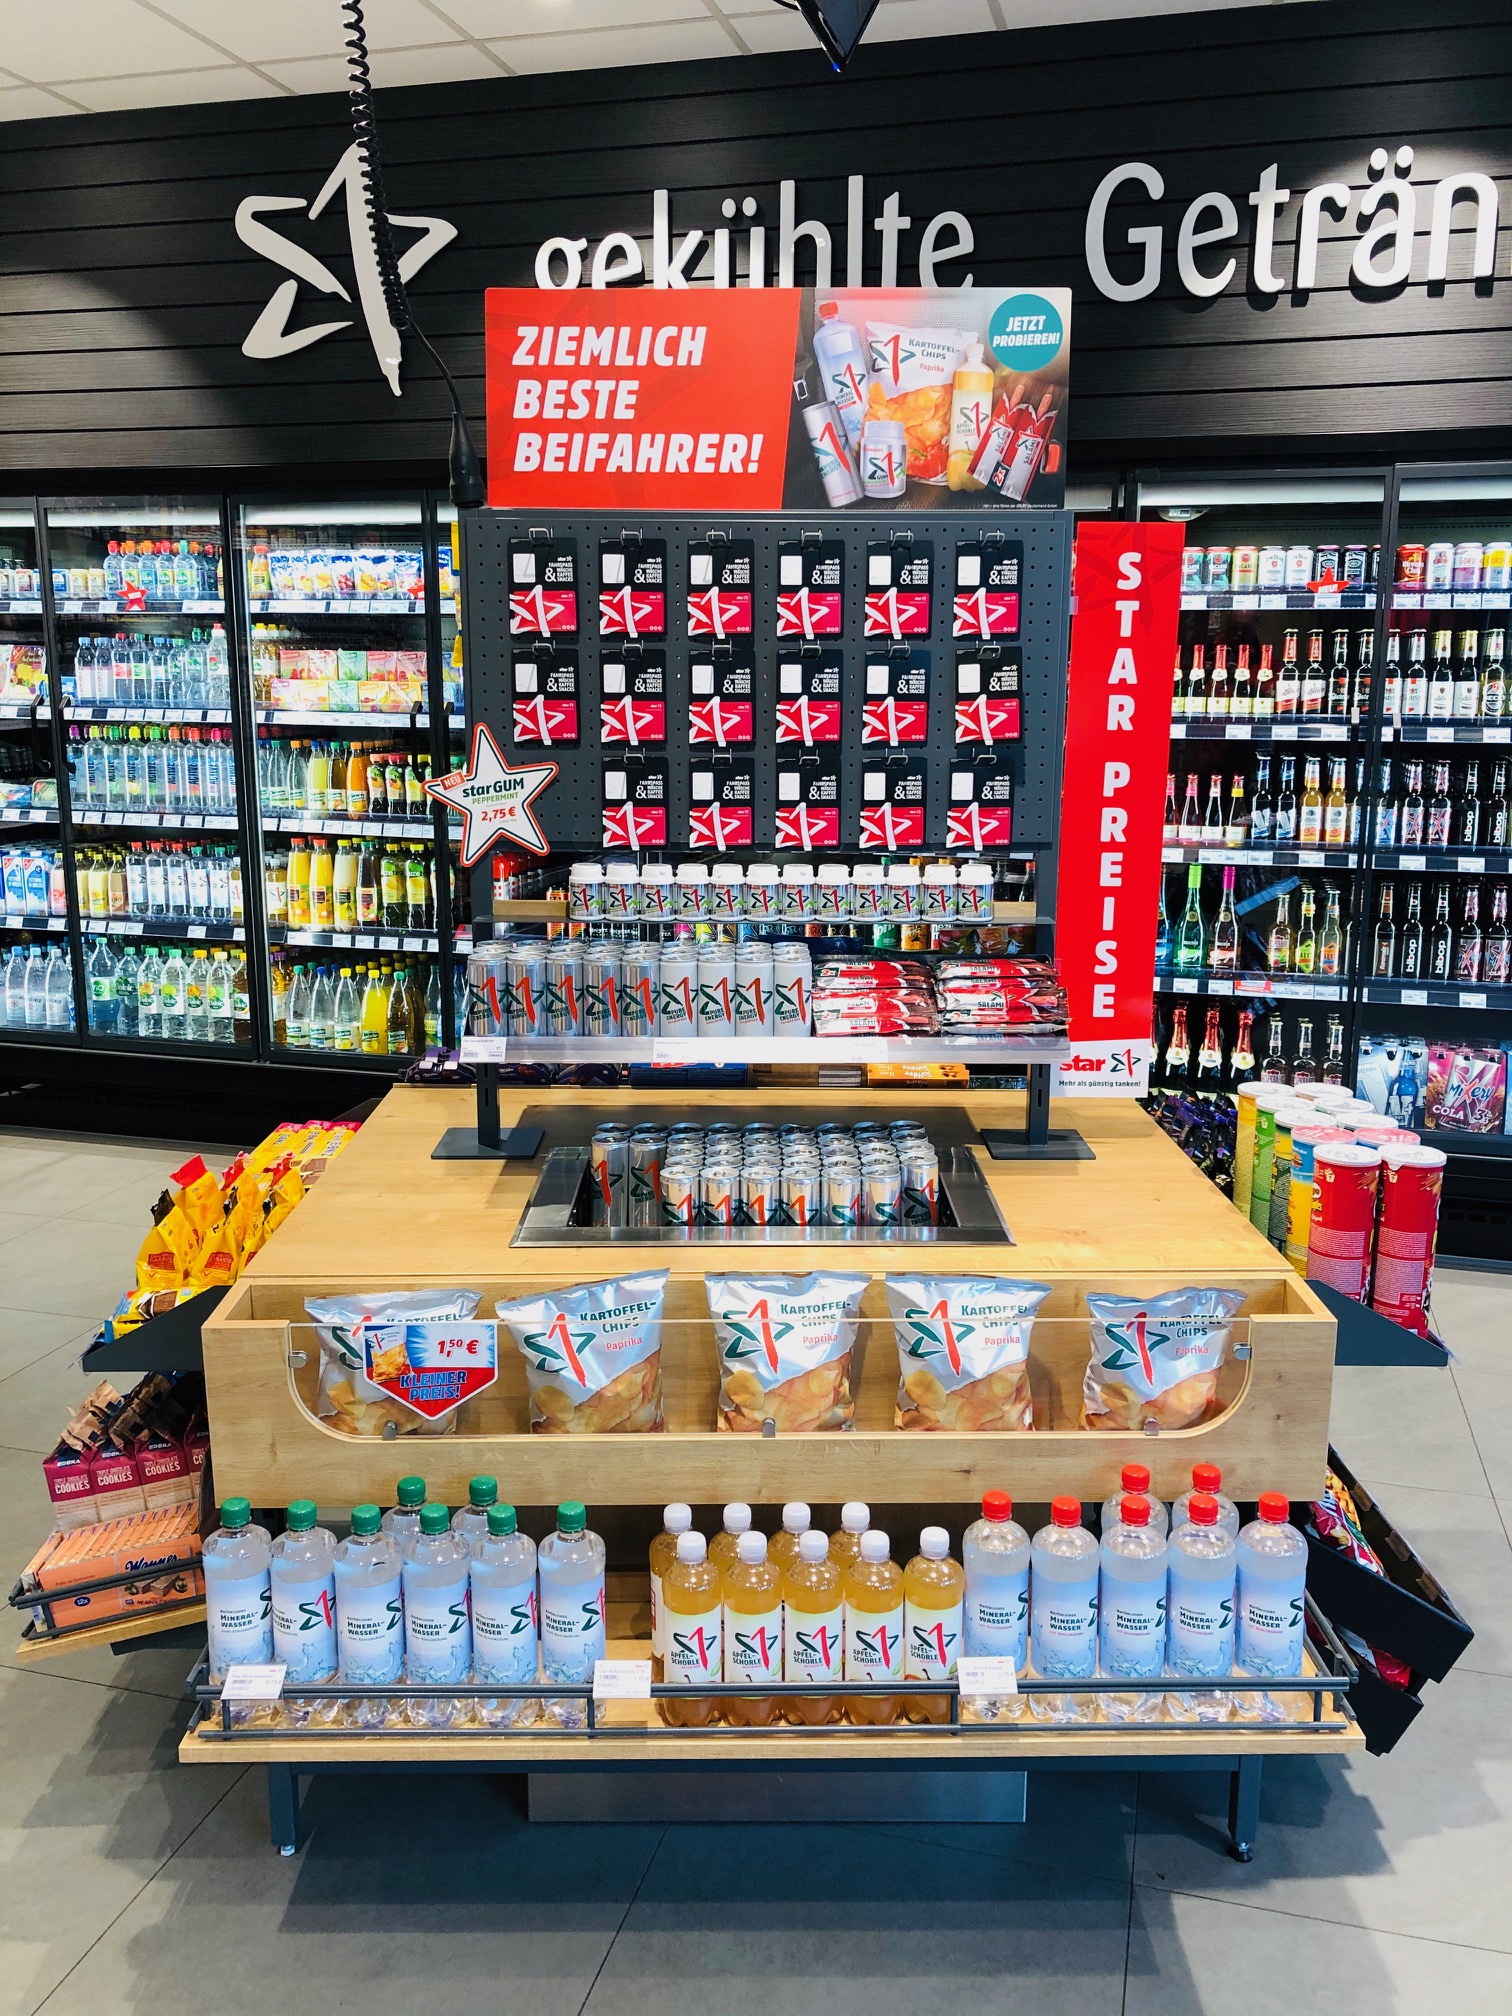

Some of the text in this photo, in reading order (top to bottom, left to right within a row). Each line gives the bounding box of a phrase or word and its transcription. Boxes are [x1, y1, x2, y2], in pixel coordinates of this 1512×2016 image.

[1085, 145, 1498, 301] Geträn
[1005, 315, 1046, 332] JETZT
[512, 326, 707, 367] ZIEMLICH
[908, 338, 960, 354] KARTOFFEL-
[992, 333, 1060, 348] PROBIEREN!
[921, 349, 947, 360] CHIPS
[919, 362, 945, 373] Paprika
[512, 379, 639, 420] BESTE
[995, 428, 1008, 452] SALAMI
[513, 432, 764, 474] BEIFAHRER!
[1023, 439, 1037, 464] SALAMI
[992, 467, 1006, 487] 2x
[545, 567, 557, 582] &
[634, 568, 646, 583] &
[722, 569, 734, 584] &
[1317, 584, 1339, 594] NEU!
[1107, 552, 1142, 732] STAR
[990, 676, 1002, 691] &
[444, 774, 461, 788] NEU
[462, 778, 525, 798] starGUM
[472, 792, 519, 805] PEPPERMINT
[481, 806, 516, 822] 2,75 €
[1464, 811, 1474, 842] bibop
[1493, 812, 1503, 843] bibop
[1092, 762, 1131, 1018] PREISE
[1406, 939, 1417, 972] bibop
[1435, 940, 1446, 974] bibop
[670, 1007, 685, 1015] PURE
[709, 1007, 724, 1015] PURE
[738, 1012, 757, 1020] ENERGY
[780, 1012, 800, 1020] ENERGY
[1060, 1054, 1106, 1072] star
[1450, 1079, 1495, 1101] MiXery
[1432, 1104, 1464, 1120] COLA
[580, 1299, 657, 1324] KARTOFFEL-
[780, 1300, 852, 1316] KARTOFFEL-
[961, 1302, 1031, 1317] KARTOFFEL-
[601, 1316, 640, 1333] CHIPS
[802, 1313, 837, 1327] CHIPS
[982, 1315, 1020, 1329] CHIPS
[1159, 1313, 1224, 1328] KARTOFFEL-
[1176, 1326, 1209, 1338] CHIPS
[605, 1336, 643, 1352] Paprika
[802, 1333, 838, 1345] Paprika
[984, 1334, 1021, 1347] Paprika
[437, 1339, 479, 1358] 1,50 €
[1175, 1345, 1210, 1356] Paprika
[400, 1370, 467, 1388] KLEINER
[409, 1385, 461, 1402] PREIS!
[149, 1442, 171, 1450] EDEKA
[56, 1459, 81, 1467] EDEKA
[145, 1462, 181, 1476] COOKIES
[97, 1472, 133, 1486] COOKIES
[54, 1480, 90, 1494] COOKIES
[220, 1611, 259, 1622] MINERAL-
[979, 1608, 1016, 1618] MINERAL-
[1050, 1615, 1087, 1624] MINERAL-
[1117, 1614, 1154, 1624] MINERAL-
[1180, 1611, 1218, 1623] MINERAL-
[1249, 1609, 1288, 1622] MINERAL-
[220, 1619, 253, 1628] WASSER
[347, 1621, 386, 1630] MINERAL-
[411, 1619, 447, 1630] MINERAL-
[475, 1616, 509, 1629] MINERAL-
[545, 1614, 580, 1627] MINERAL-
[979, 1616, 1010, 1624] WASSER
[1116, 1622, 1148, 1631] WASSER
[1179, 1619, 1211, 1630] WASSER
[1249, 1616, 1281, 1629] WASSER
[347, 1628, 379, 1636] WASSER
[411, 1628, 440, 1636] WASSER
[475, 1624, 502, 1636] WASSER
[545, 1622, 574, 1633] WASSER
[1050, 1623, 1082, 1631] WASSER
[671, 1651, 694, 1659] APFEL-
[732, 1651, 756, 1659] APFEL-
[793, 1650, 817, 1658] APFEL-
[853, 1649, 876, 1658] APFEL-
[910, 1644, 932, 1653] APFEL-
[910, 1650, 939, 1660] SCHORLE
[671, 1657, 701, 1665] SCHORLE
[732, 1657, 762, 1665] SCHORLE
[853, 1655, 883, 1664] SCHORLE
